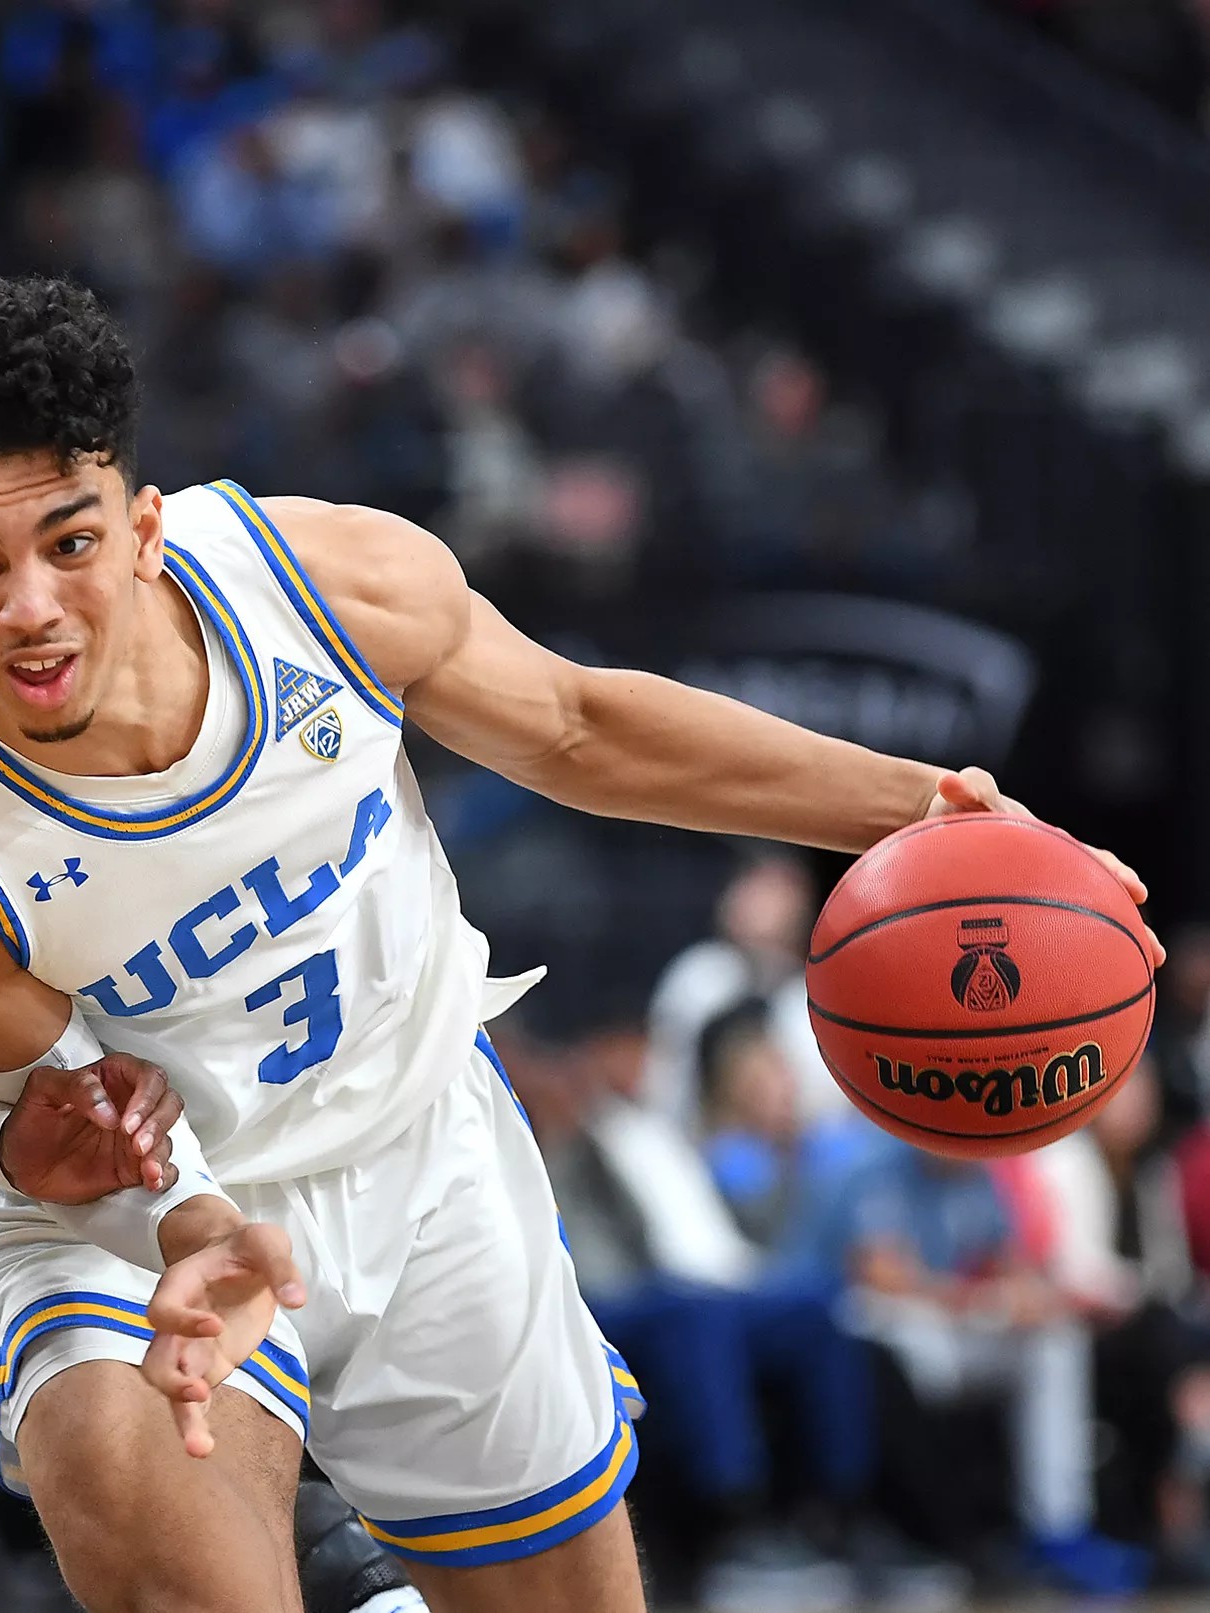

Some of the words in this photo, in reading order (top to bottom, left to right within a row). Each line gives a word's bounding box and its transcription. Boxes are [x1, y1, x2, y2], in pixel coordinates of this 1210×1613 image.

[281, 677, 323, 723] JRW
[77, 787, 392, 1017] UCLA
[244, 948, 344, 1085] 3
[874, 1040, 1107, 1117] Wilson
